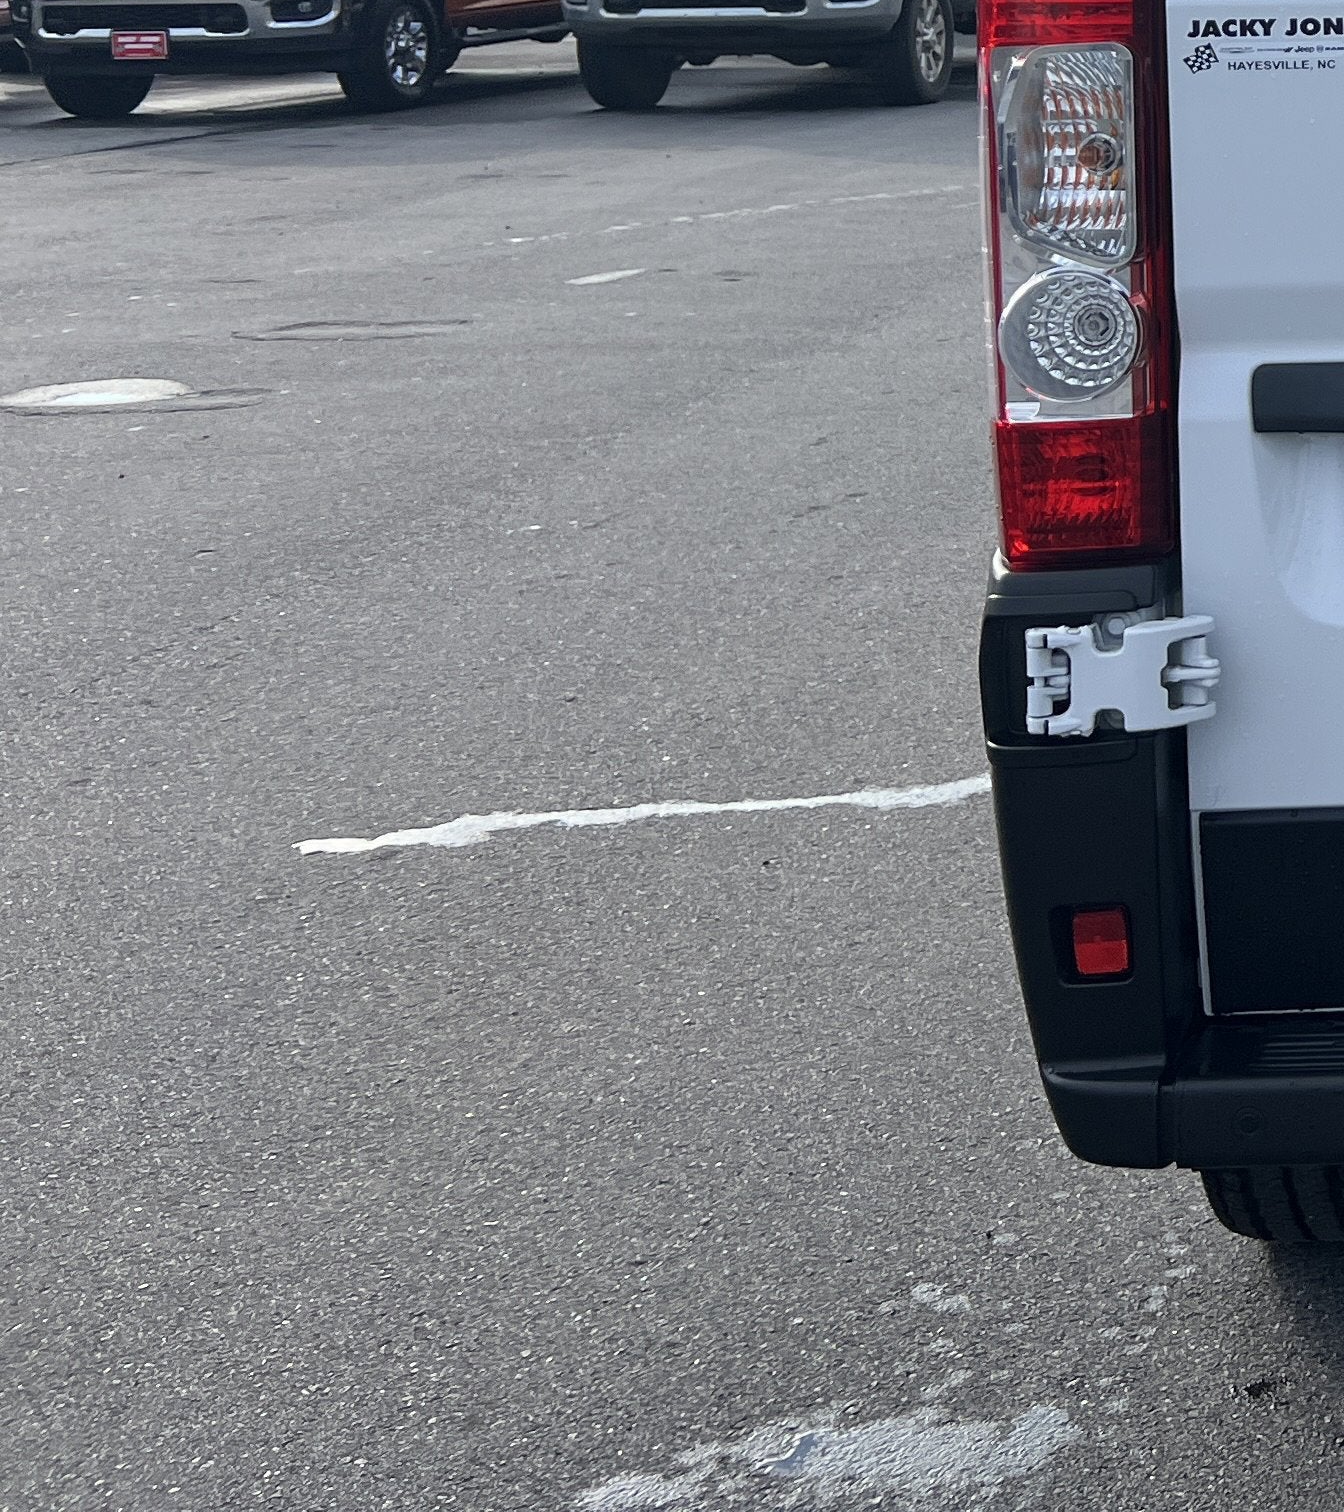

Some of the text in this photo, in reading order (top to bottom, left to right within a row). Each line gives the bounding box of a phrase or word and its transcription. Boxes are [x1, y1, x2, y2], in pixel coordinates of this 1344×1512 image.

[1187, 19, 1277, 37] JACKY
[1227, 59, 1336, 70] HAYESVILLE, NC
